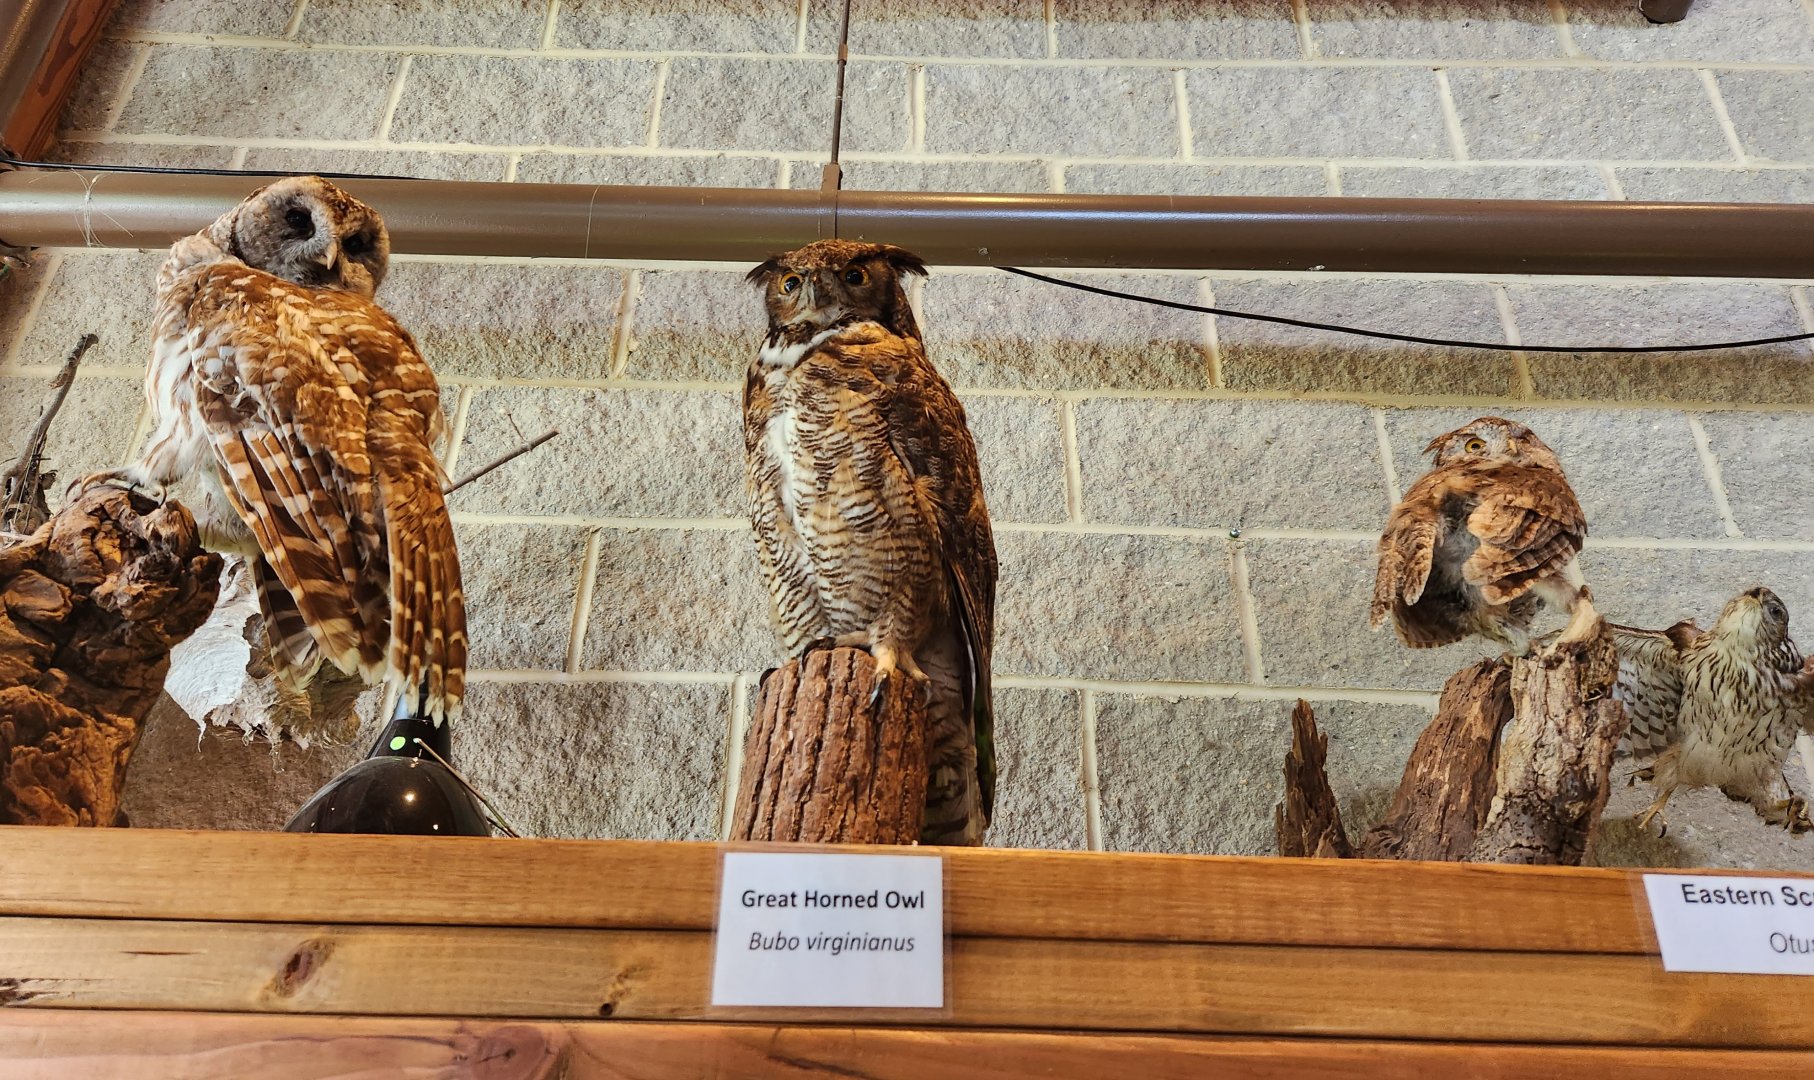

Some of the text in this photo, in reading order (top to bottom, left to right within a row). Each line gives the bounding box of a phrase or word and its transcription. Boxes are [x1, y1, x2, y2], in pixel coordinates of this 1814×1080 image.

[742, 890, 925, 909] Great Horned Owl
[1681, 883, 1814, 906] Eastern Sc
[749, 931, 915, 956] Bubo virginianus
